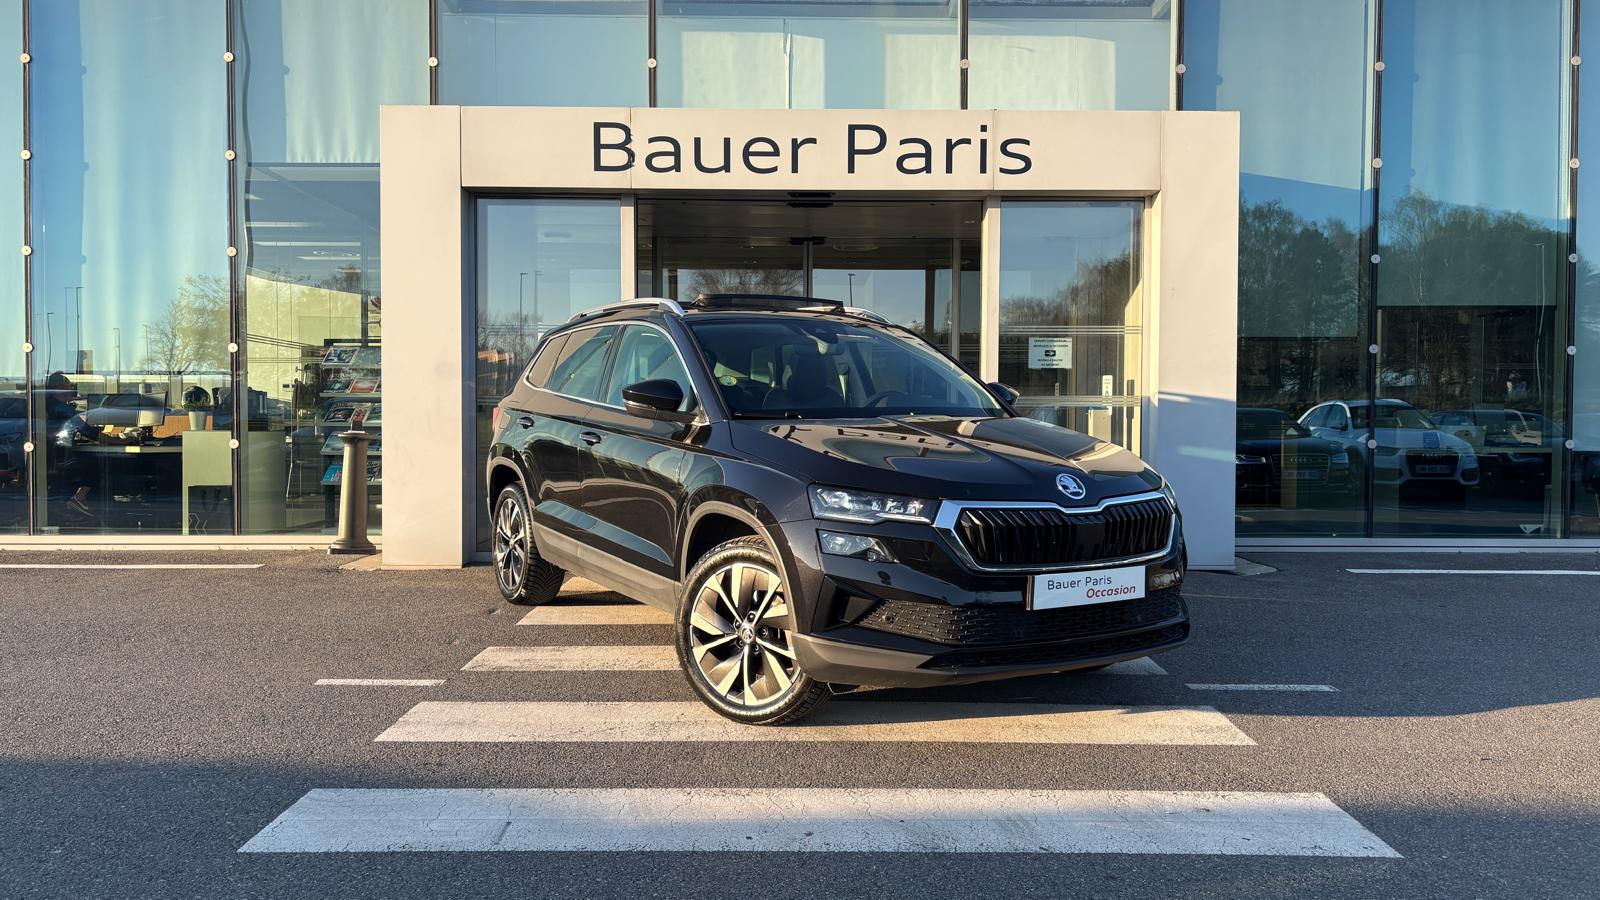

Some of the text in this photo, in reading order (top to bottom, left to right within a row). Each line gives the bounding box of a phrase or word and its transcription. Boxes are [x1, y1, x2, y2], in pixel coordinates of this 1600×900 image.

[593, 121, 1033, 175] Bauer Paris
[1047, 575, 1112, 590] Bauer Paris
[1086, 585, 1136, 598] Occasion
